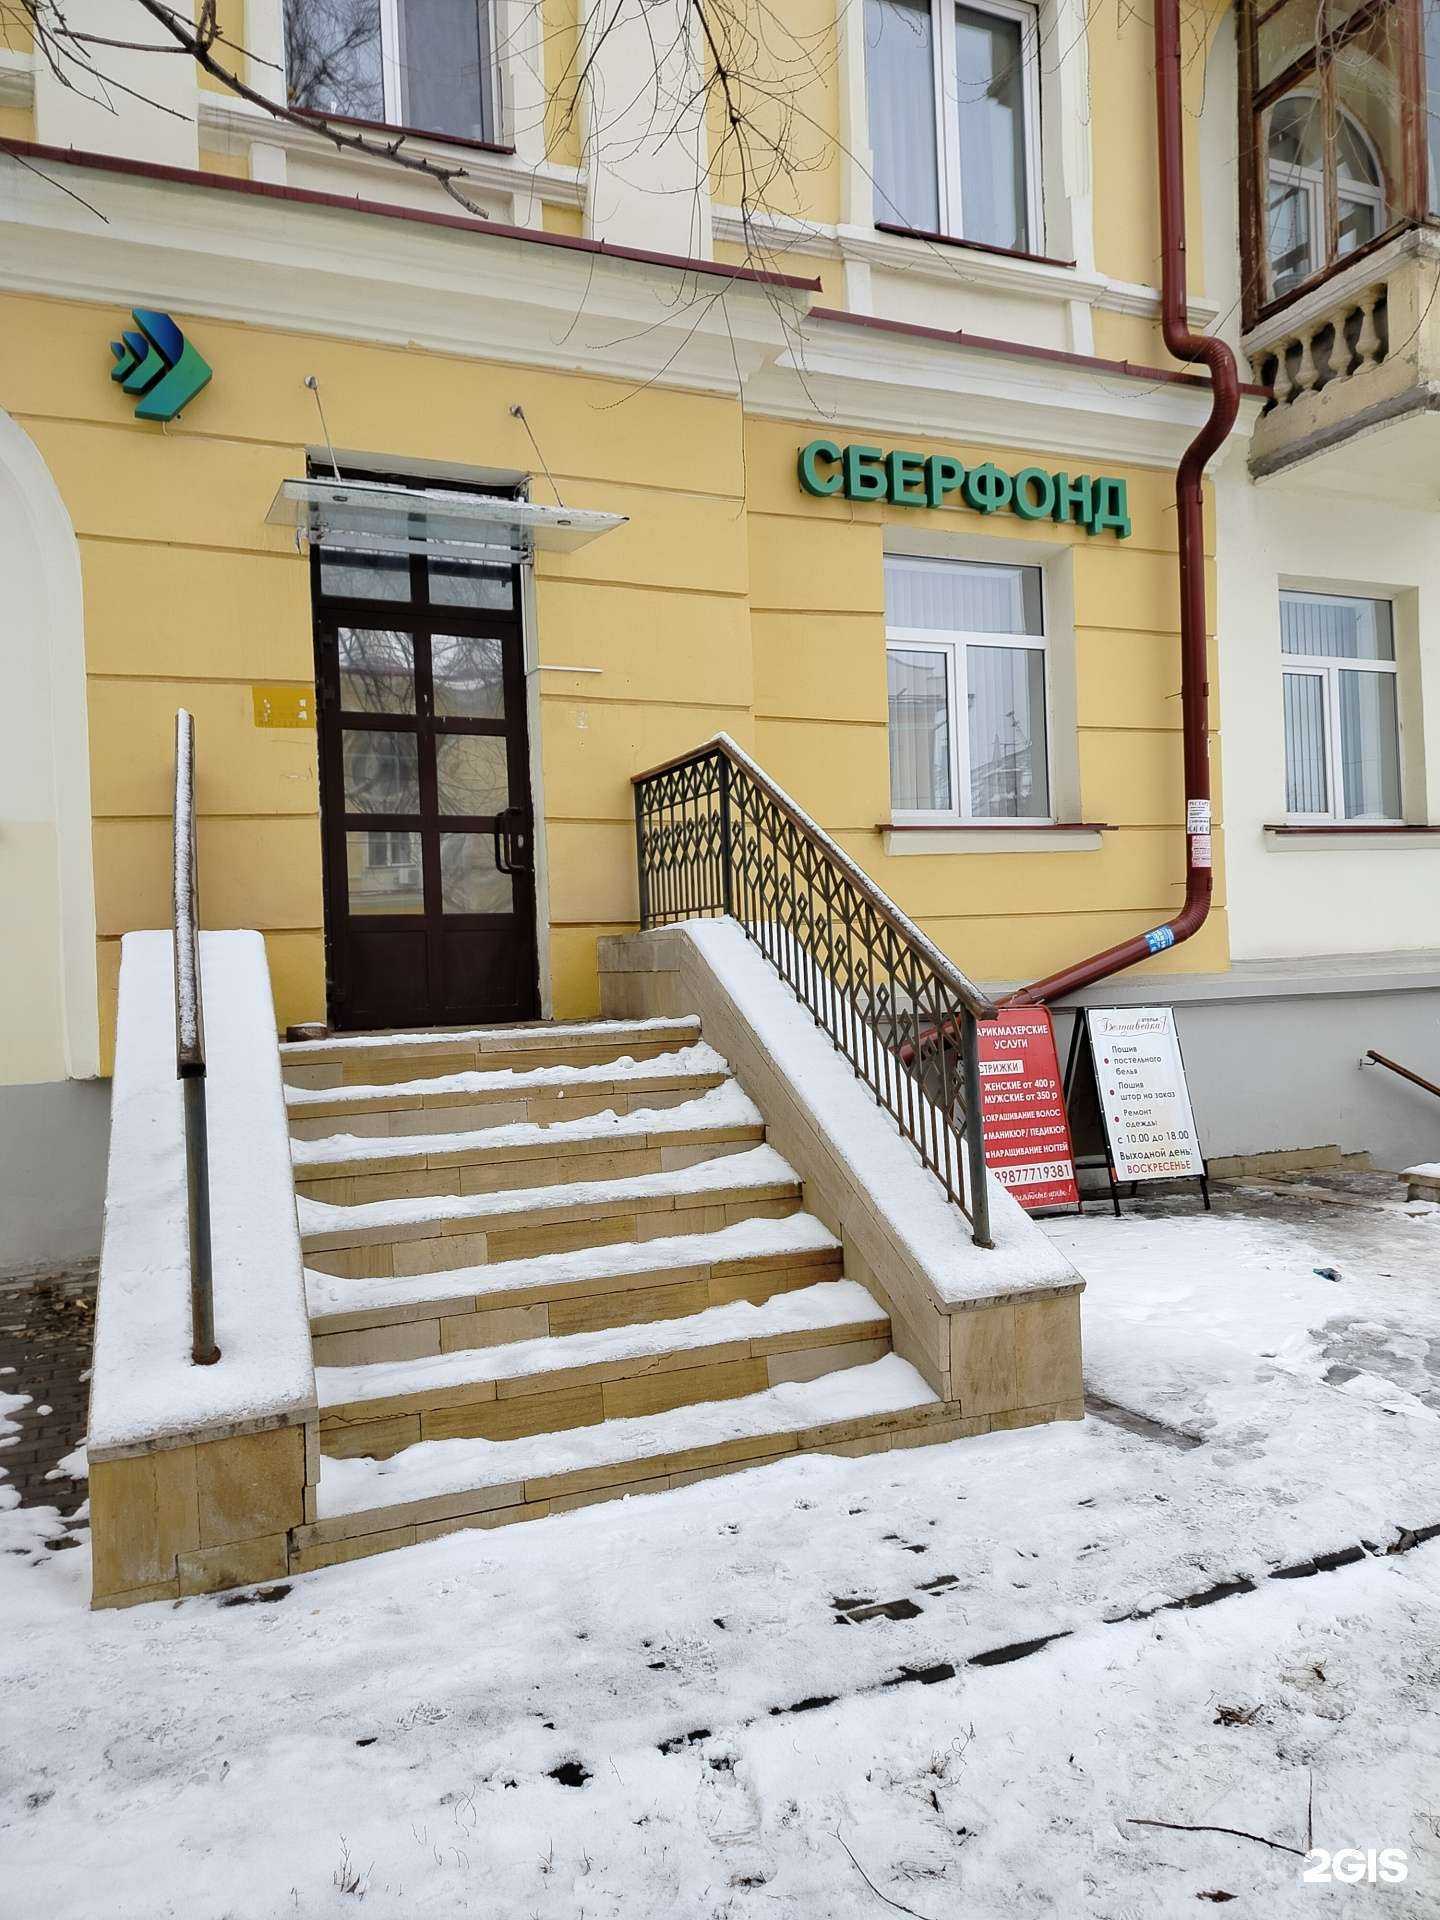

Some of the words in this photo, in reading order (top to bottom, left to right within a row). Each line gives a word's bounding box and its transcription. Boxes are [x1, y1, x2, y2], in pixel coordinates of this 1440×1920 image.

[799, 440, 1132, 539] СБЕРФОНД
[977, 1024, 1049, 1037] АРИКМАХЕРСКИЕ
[994, 1039, 1028, 1050] УСЛУГИ
[1112, 1045, 1138, 1054] Пошив
[1114, 1056, 1162, 1065] постельного
[1116, 1067, 1138, 1076] белья
[984, 1081, 1021, 1092] ЖЕНСКИЕ
[1034, 1079, 1048, 1088] 400
[1118, 1081, 1144, 1089] Пошив
[984, 1092, 1024, 1104] МУЖСКИЕ
[1036, 1091, 1050, 1101] 350
[1121, 1093, 1142, 1101] штор
[1156, 1091, 1176, 1099] заказ
[986, 1110, 1036, 1122] ОКРАШИВАНИЕ
[1036, 1109, 1061, 1118] ВОЛОС
[1123, 1108, 1152, 1117] Ремонт
[1125, 1120, 1158, 1129] одежды
[1030, 1125, 1066, 1137] ПЕДИКЮР
[1126, 1133, 1150, 1144] 10.00
[1152, 1134, 1164, 1143] до
[1166, 1130, 1190, 1141] 18.00
[991, 1146, 1043, 1158] НАРАЩИВАНИЕ
[1043, 1142, 1069, 1153] НОГТЕЙ
[1119, 1148, 1167, 1160] Выходной
[1169, 1147, 1193, 1158] день:
[1127, 1160, 1191, 1174] ВОСКРЕСЕНЬЕ
